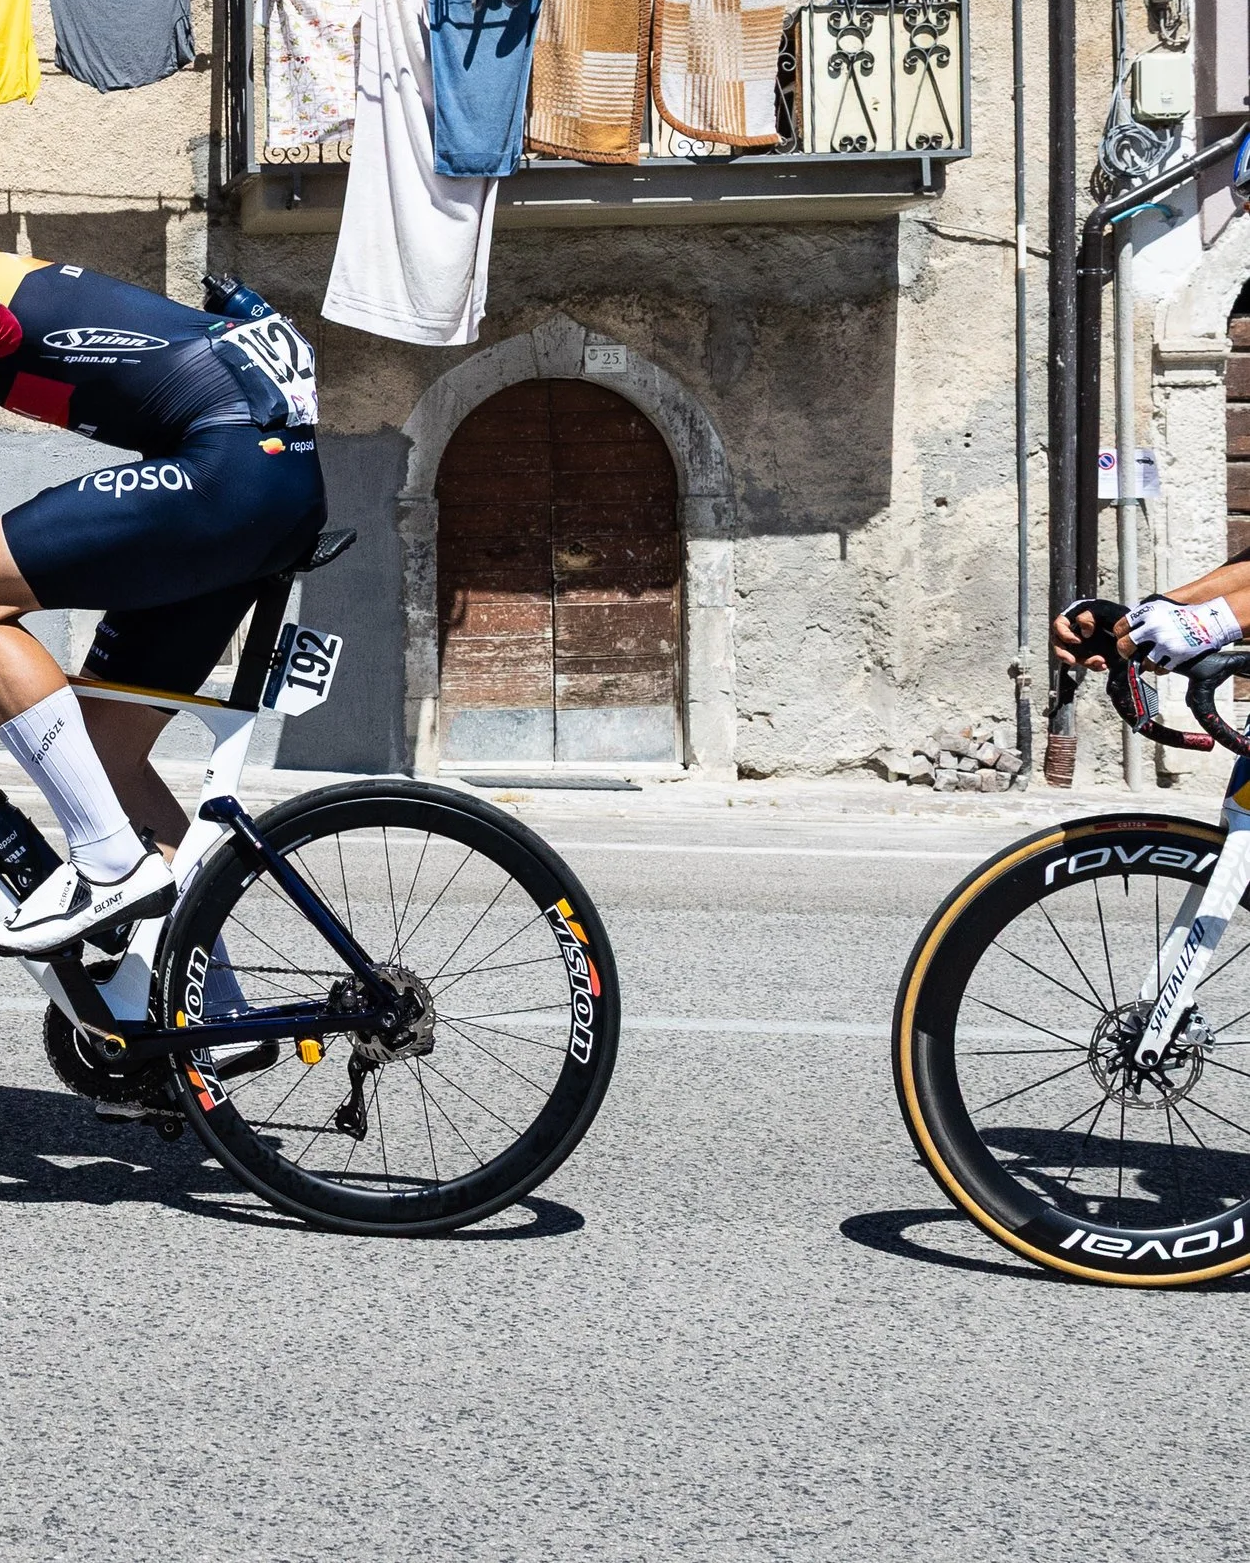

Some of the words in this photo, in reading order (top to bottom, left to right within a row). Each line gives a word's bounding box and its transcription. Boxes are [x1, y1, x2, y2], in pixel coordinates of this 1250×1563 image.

[53, 328, 149, 349] Spinn
[63, 354, 118, 364] spinn.no
[290, 440, 315, 454] repsol
[77, 464, 194, 498] repsol
[286, 630, 338, 697] 192
[1117, 820, 1147, 829] COTTON
[1044, 844, 1218, 887] roval
[94, 891, 124, 914] BONT
[1150, 918, 1205, 1036] SPECIALIZED
[1059, 1217, 1245, 1260] roval
